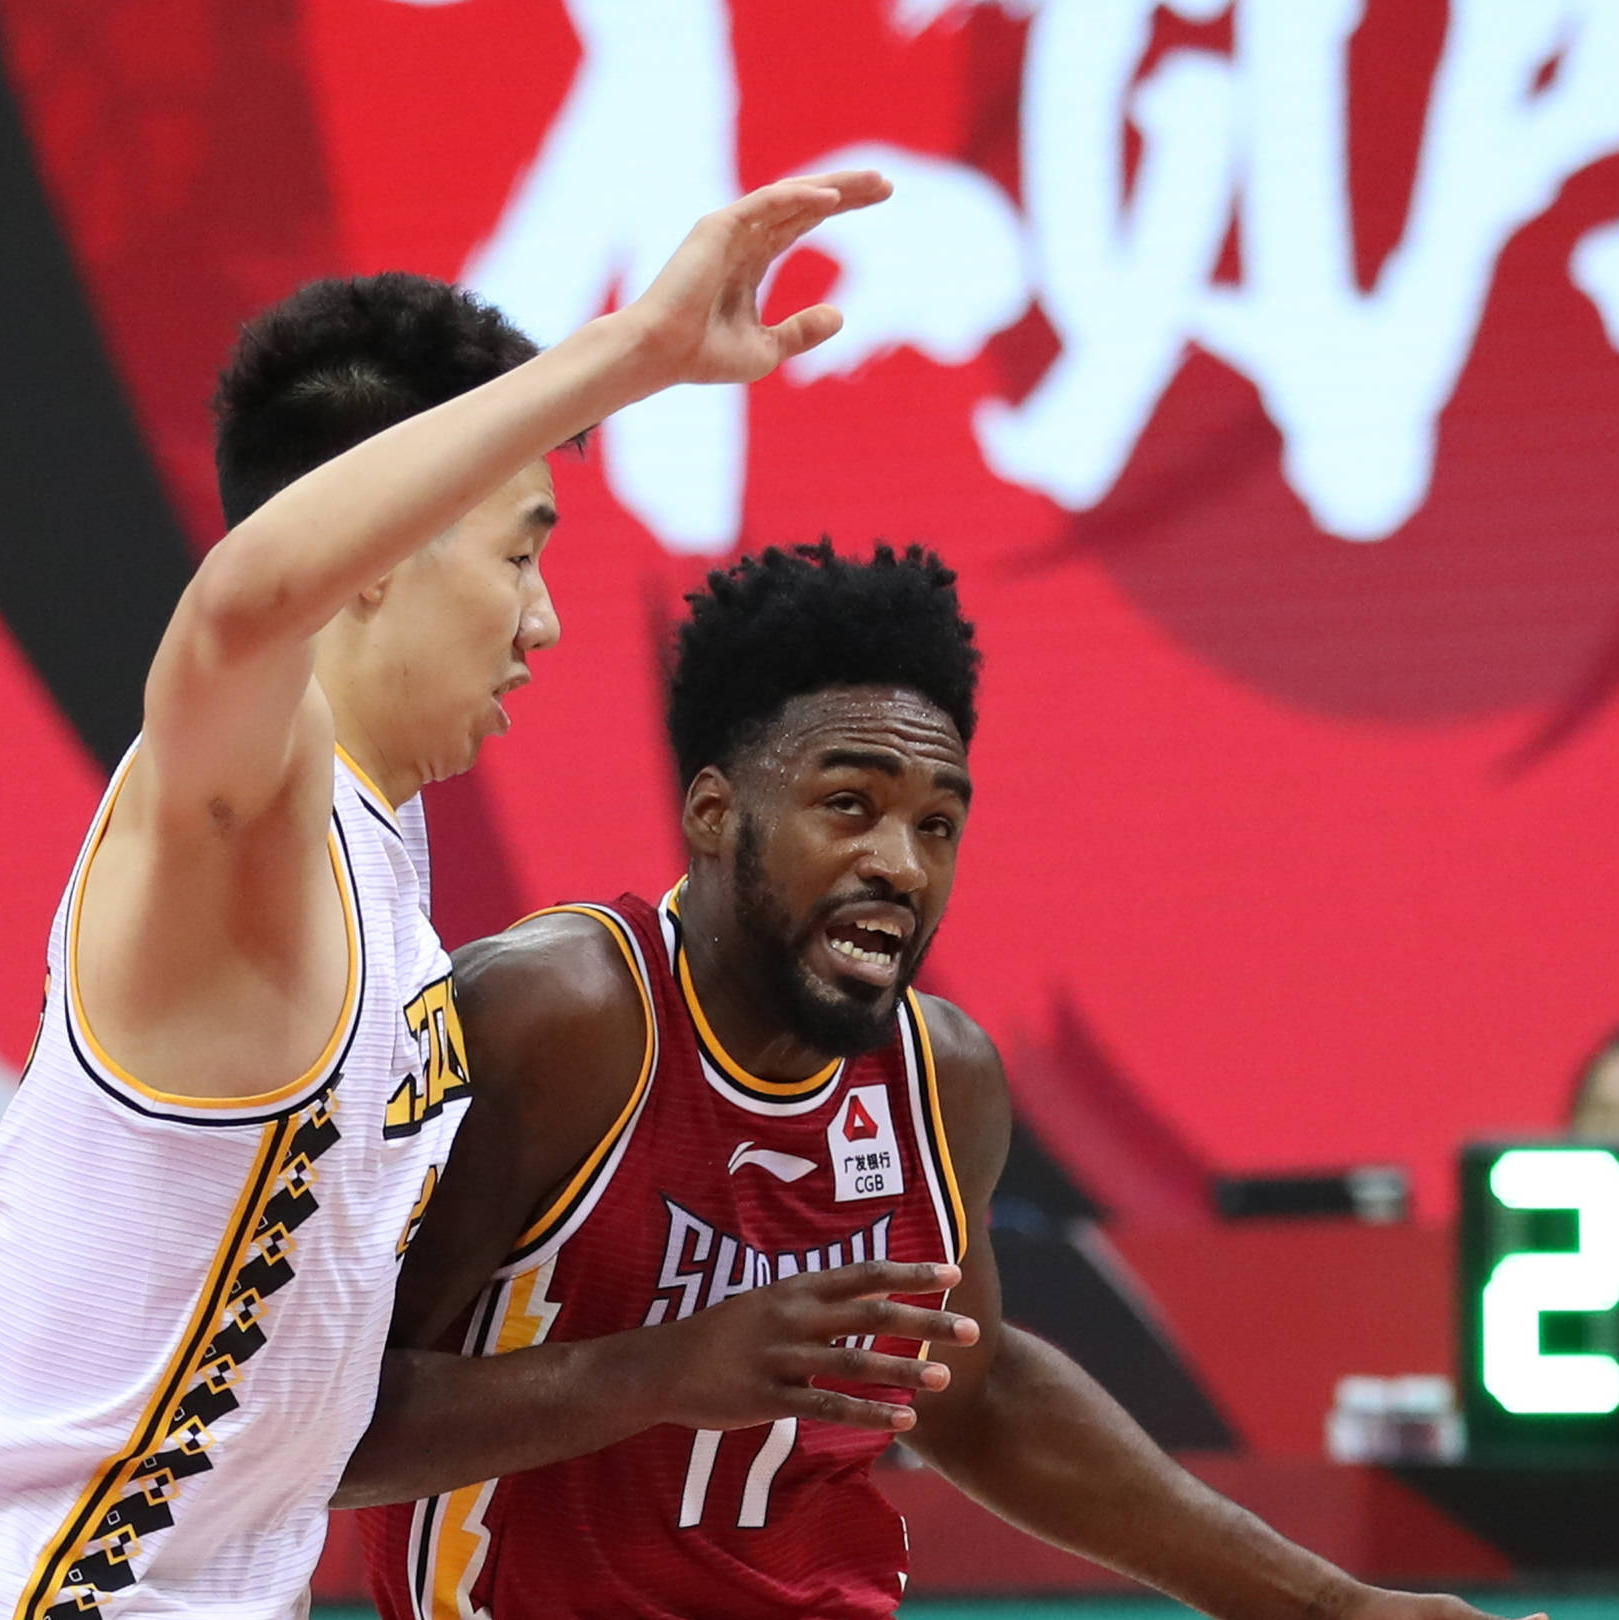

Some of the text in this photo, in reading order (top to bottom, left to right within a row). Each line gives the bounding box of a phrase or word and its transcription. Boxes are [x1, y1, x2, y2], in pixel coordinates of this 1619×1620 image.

[843, 1151, 892, 1174] 广发银行
[854, 1174, 886, 1194] CGB
